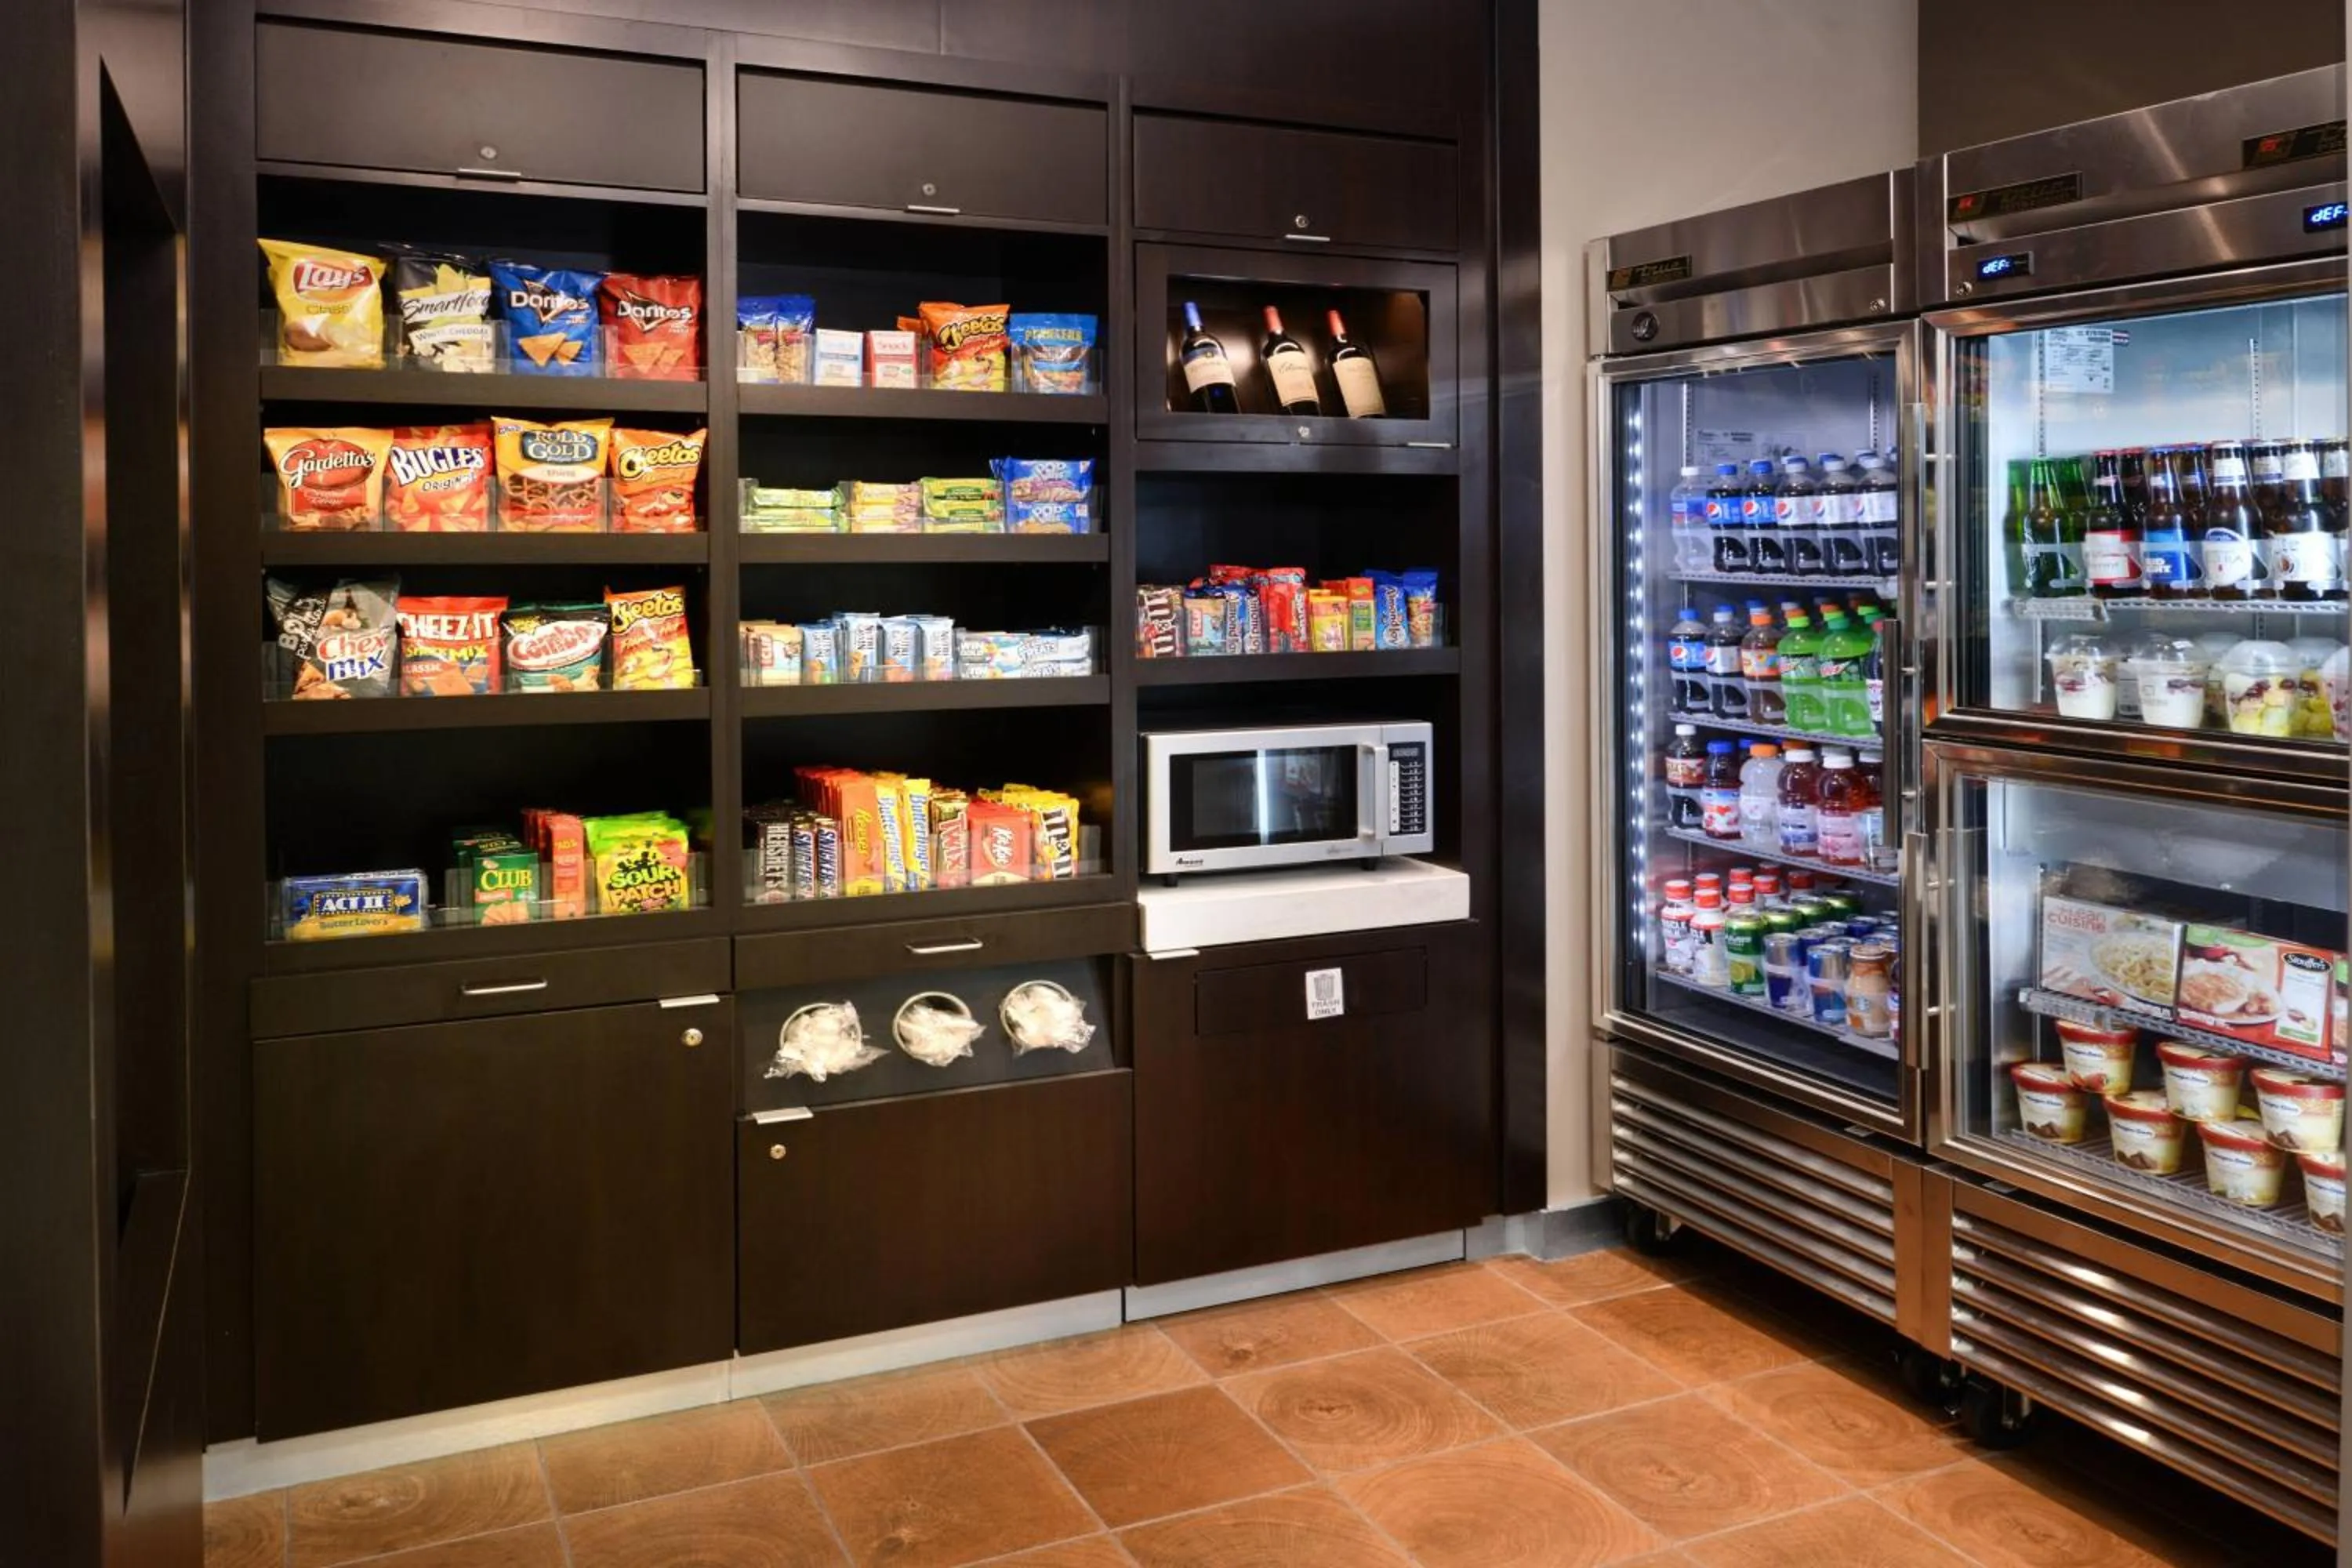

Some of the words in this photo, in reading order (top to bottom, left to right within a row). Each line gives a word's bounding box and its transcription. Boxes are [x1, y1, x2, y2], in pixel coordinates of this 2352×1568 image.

[298, 261, 365, 291] Lay's
[510, 290, 590, 309] Doritos
[617, 300, 692, 319] Doritos
[535, 430, 587, 444] ROLD
[528, 442, 593, 460] GOLD
[619, 440, 702, 480] Cheetos
[280, 449, 376, 488] Gardetto's
[391, 446, 485, 488] BUGLES
[318, 633, 390, 660] Chex
[909, 794, 929, 872] Butterfinger
[765, 823, 789, 888] HERSHEY'S
[818, 828, 837, 890] SNICKERS
[481, 869, 532, 891] CLUB
[610, 866, 681, 887] SOUR
[322, 896, 359, 912] ACT
[363, 896, 384, 909] II
[608, 881, 680, 904] PATCH
